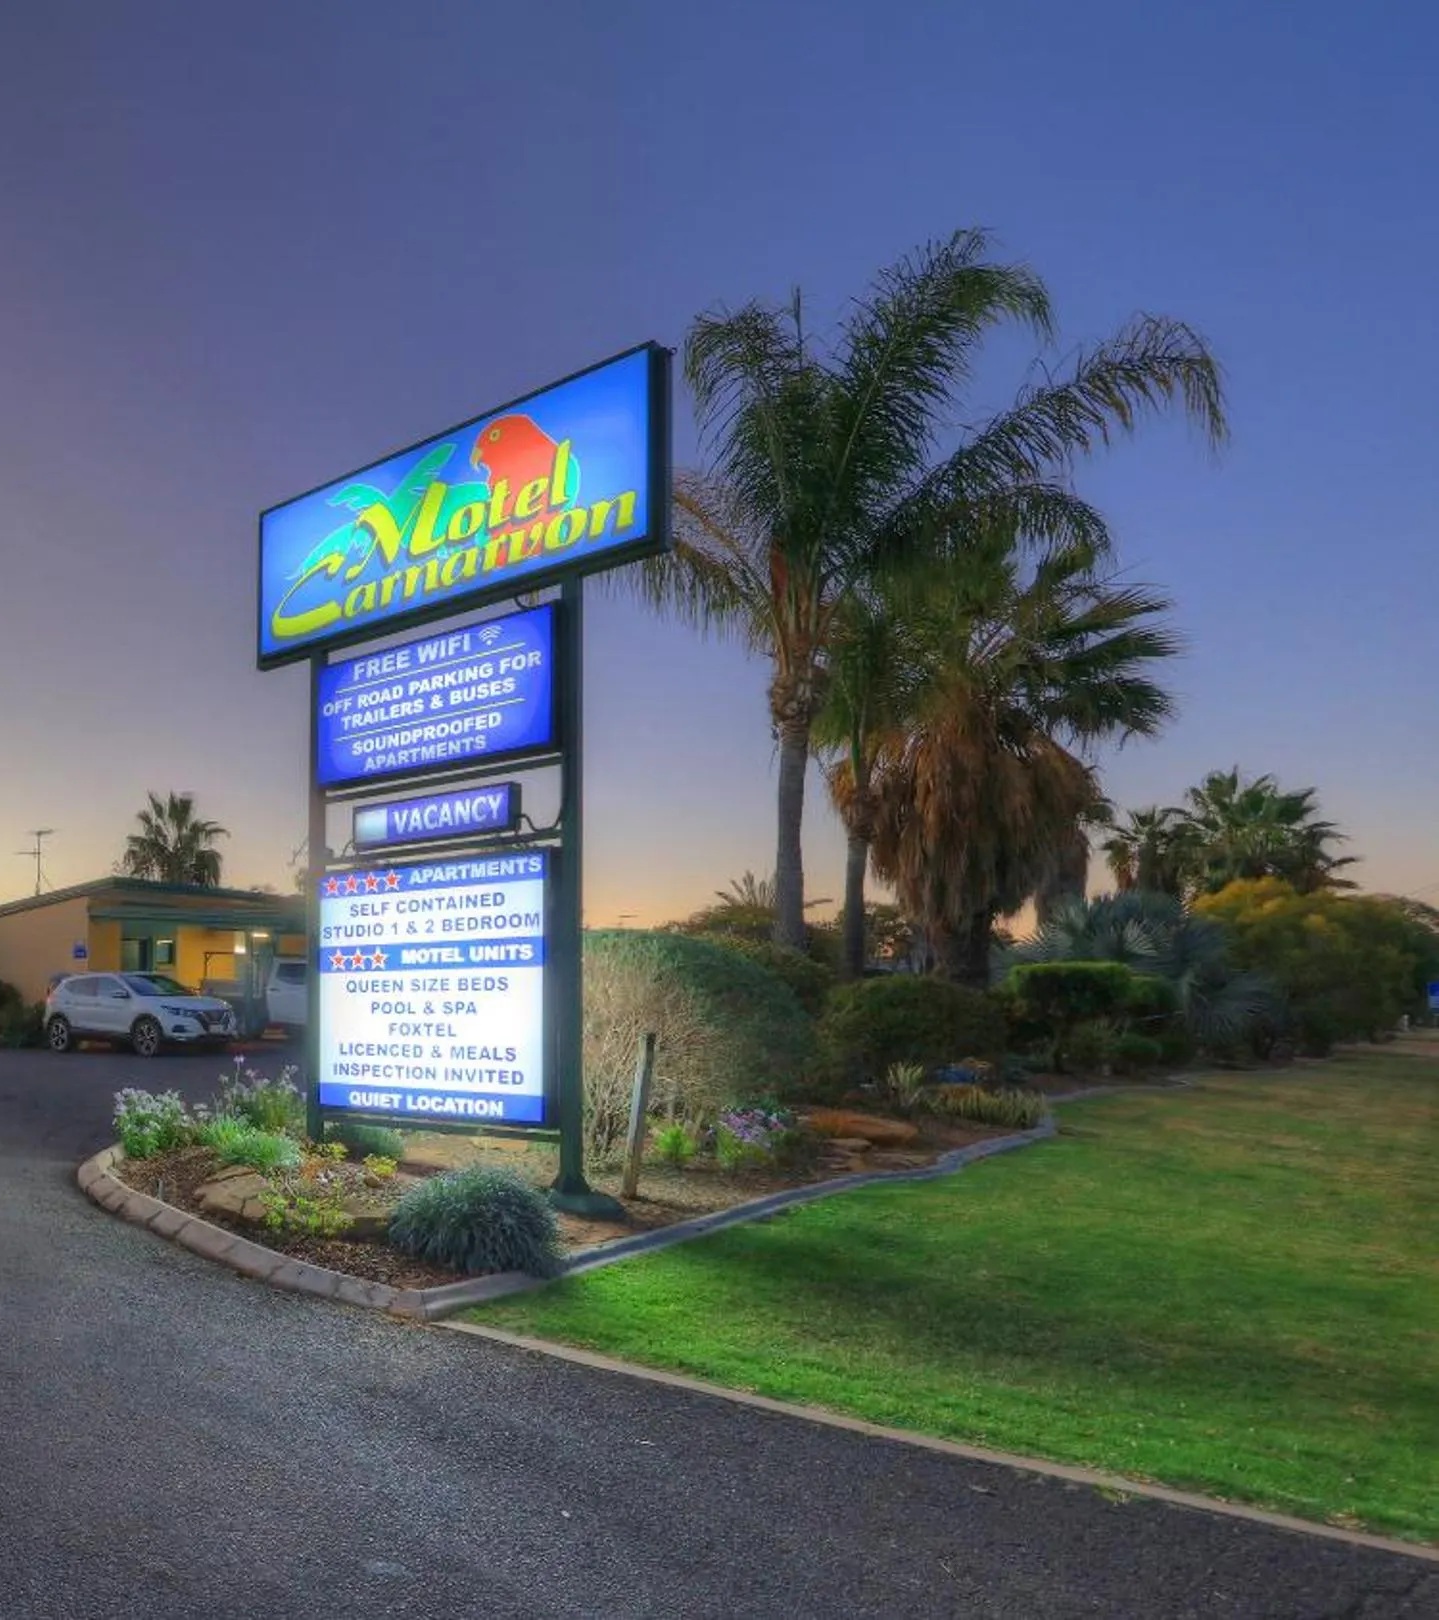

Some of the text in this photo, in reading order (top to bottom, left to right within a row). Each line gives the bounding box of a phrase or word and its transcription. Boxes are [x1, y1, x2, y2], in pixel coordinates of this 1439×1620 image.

[344, 437, 572, 582] Motel
[270, 490, 638, 640] Carnarvon
[353, 633, 471, 681] FREE WIFI
[323, 651, 542, 717] OFF ROAD PARKING FOR
[341, 678, 516, 730] TRAILERS & BUSES
[351, 711, 502, 755] SOUNDPROOFED
[363, 734, 487, 772] APARTMENTS
[393, 793, 503, 834] VACANCY
[410, 857, 541, 885] APARTMENTS
[350, 892, 506, 918] SELF CONTAINED
[323, 912, 540, 939] STUDIO 1 & 2 BEDROOM
[401, 944, 534, 964] MOTEL UNITS
[346, 976, 509, 994] QUEEN SIZE BEDS
[371, 1001, 477, 1015] POOL & SPA
[388, 1023, 457, 1037] FOXTEL
[339, 1042, 517, 1062] LICENCED & MEALS
[333, 1063, 524, 1085] INSPECTION INVITED
[348, 1091, 504, 1116] QUIET LOCATION
